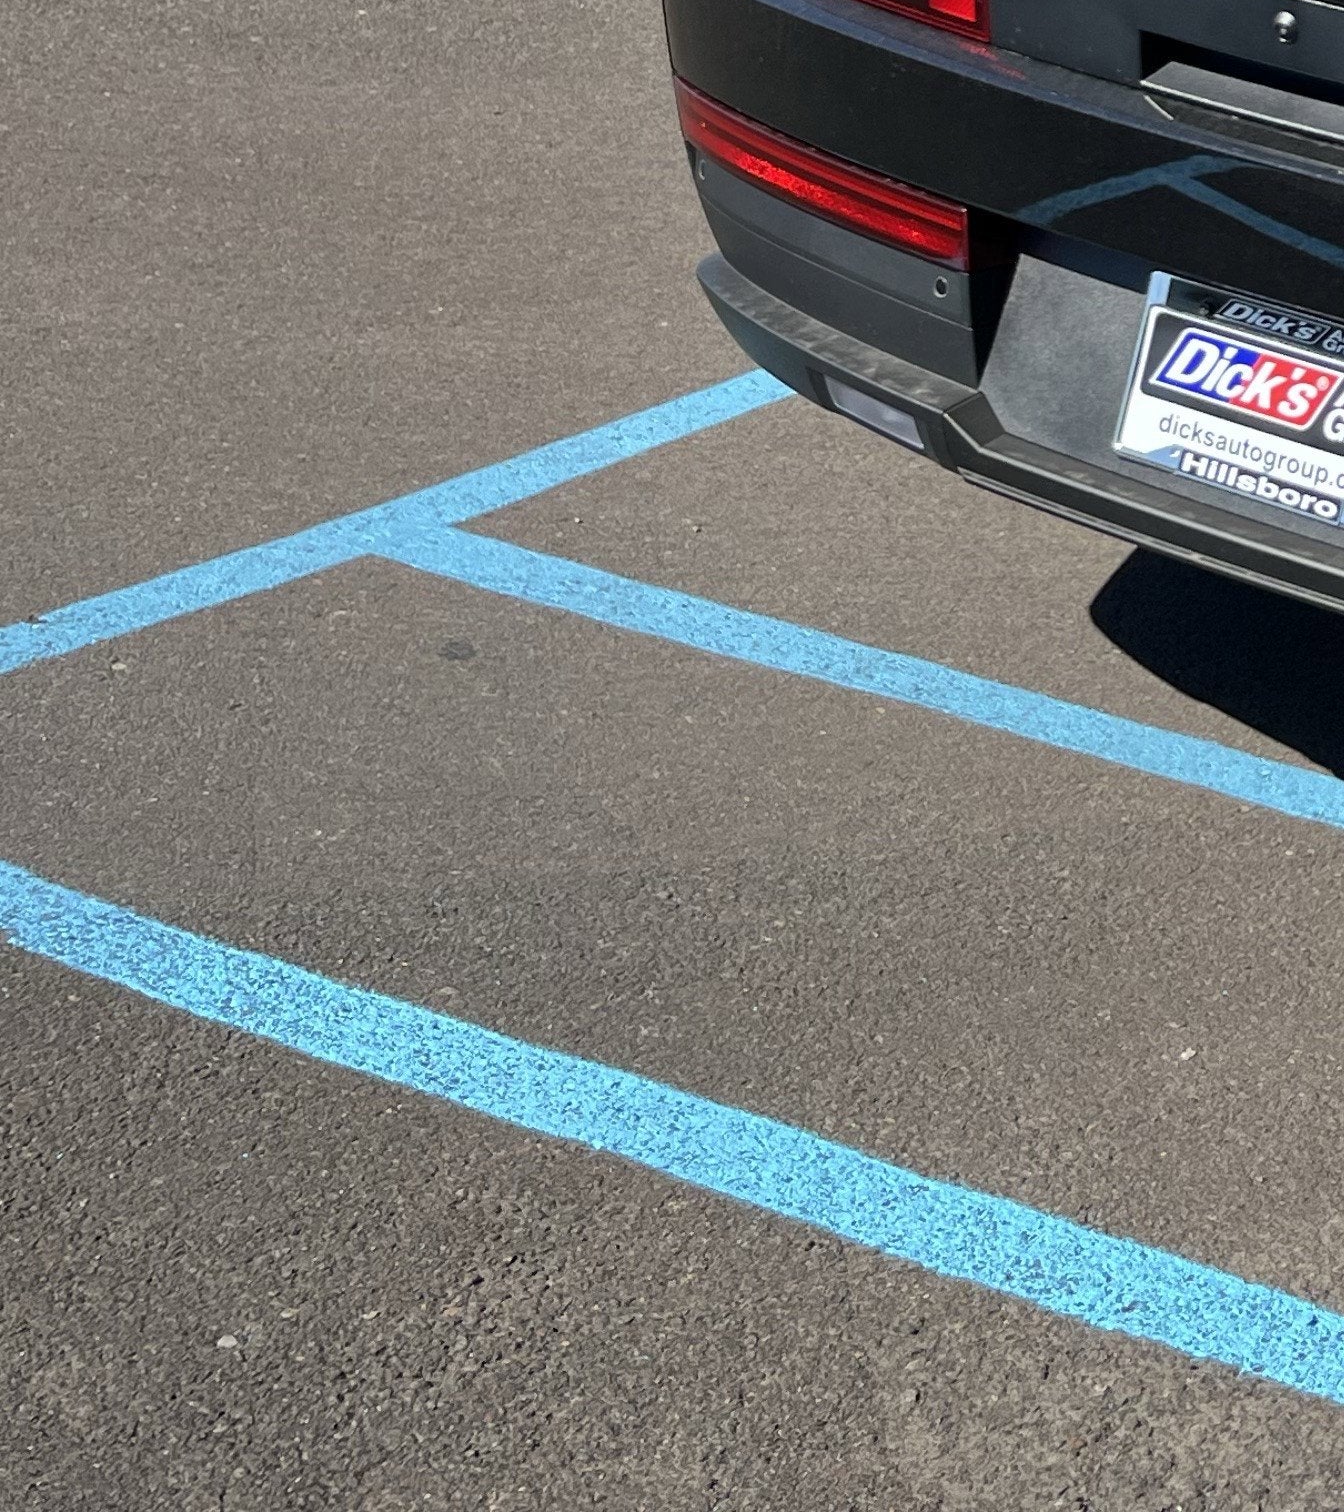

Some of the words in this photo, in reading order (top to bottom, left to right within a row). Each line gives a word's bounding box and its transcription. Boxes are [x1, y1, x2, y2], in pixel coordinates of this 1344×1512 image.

[1222, 302, 1318, 341] Dick's
[1165, 338, 1320, 419] Dick's
[1179, 452, 1339, 519] Hillsboro
